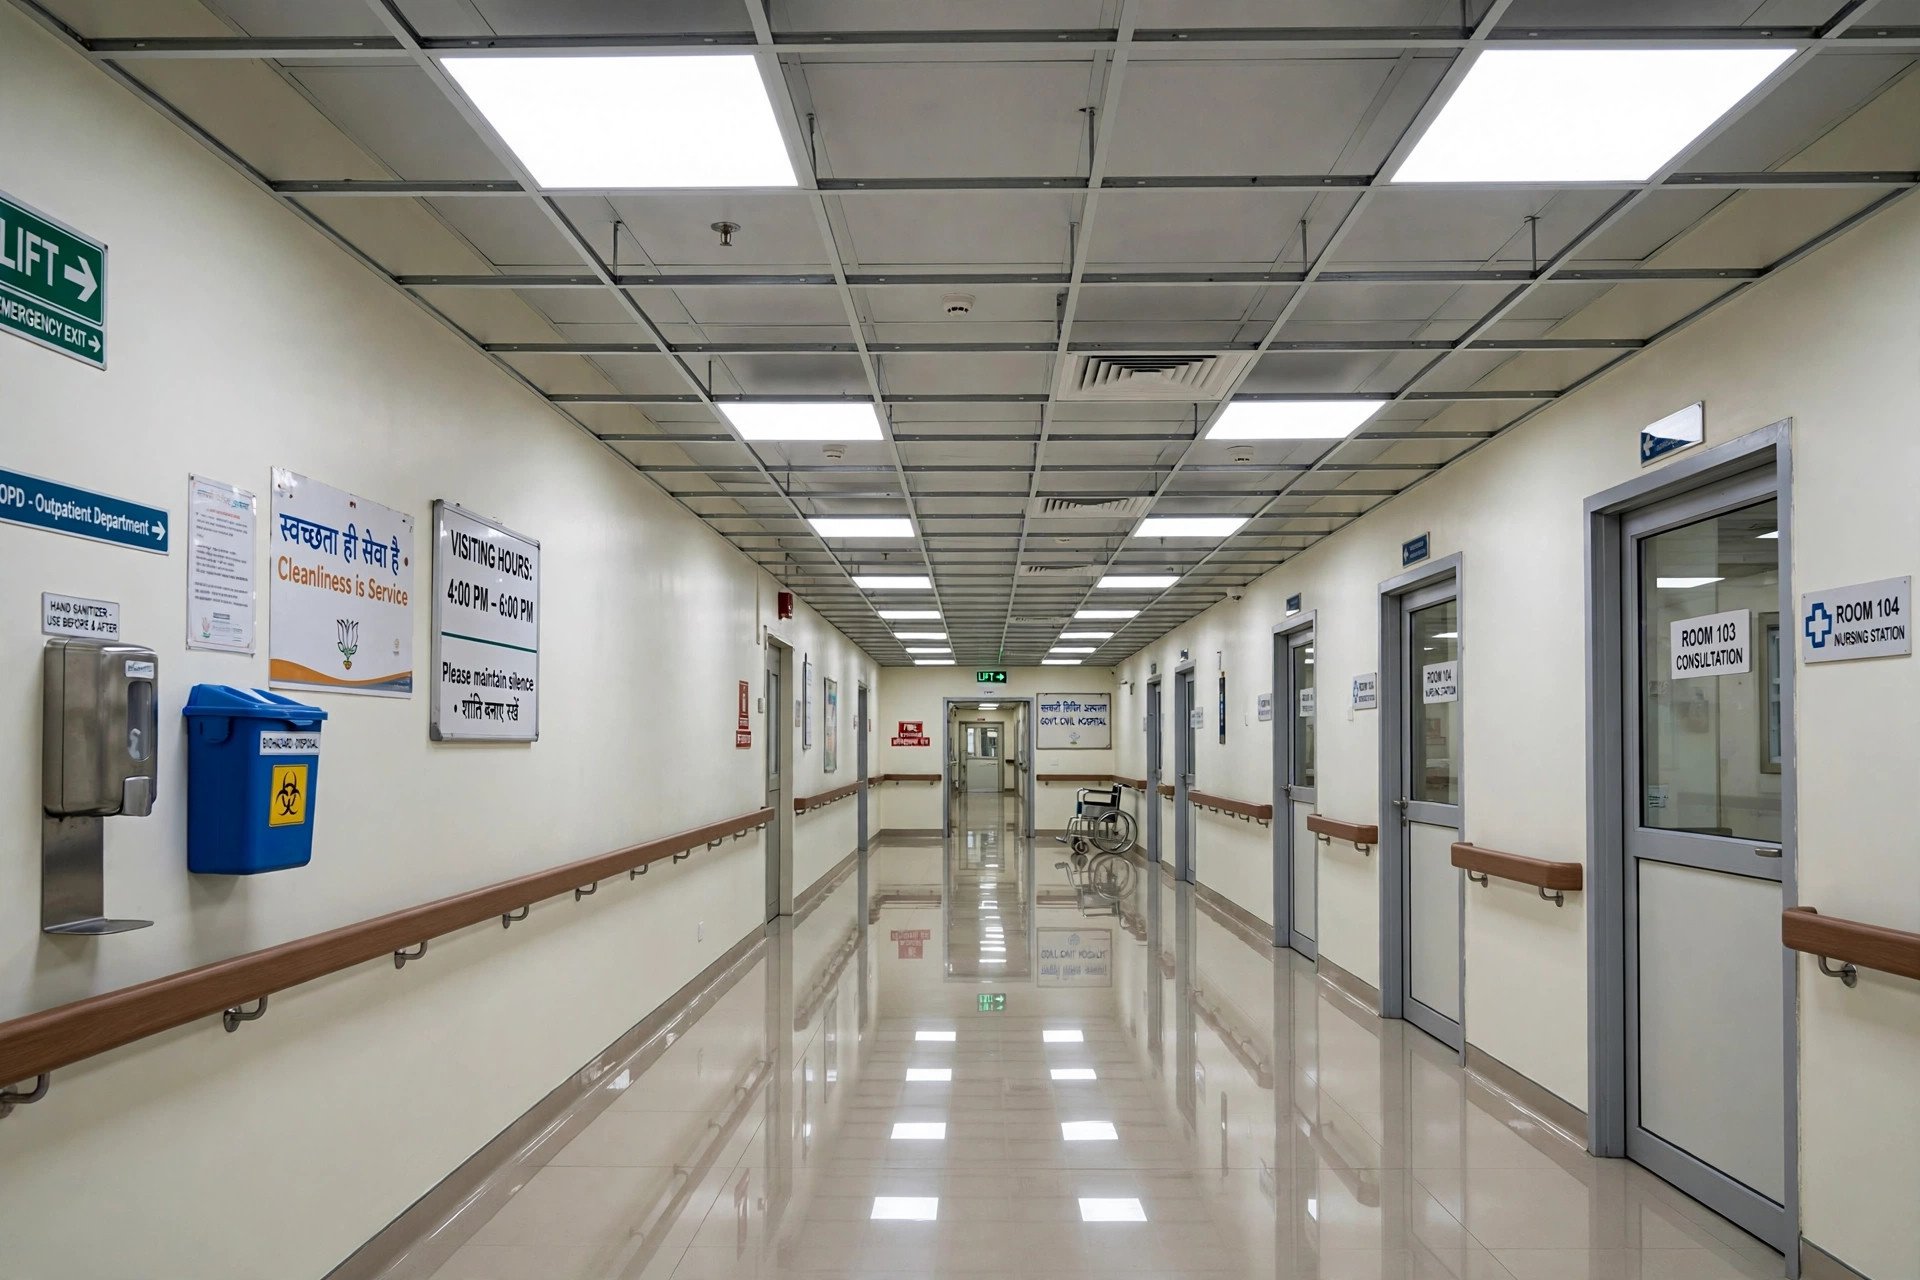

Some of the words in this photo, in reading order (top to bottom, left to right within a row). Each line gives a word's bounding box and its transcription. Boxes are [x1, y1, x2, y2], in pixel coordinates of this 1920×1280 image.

[0, 217, 60, 287] LIFT
[64, 324, 87, 348] EXIT
[0, 484, 25, 508] OPD
[35, 493, 92, 523] Outpatient
[93, 507, 150, 536] Department
[279, 512, 339, 555] स्वच्छता
[342, 523, 358, 563] ही
[362, 528, 388, 568] सेवा
[390, 535, 400, 575] है
[450, 529, 496, 569] VISITING
[497, 547, 532, 581] HOURS:
[277, 555, 352, 595] Cleanliness
[355, 573, 365, 597] is
[368, 578, 408, 606] Service
[50, 601, 71, 614] HAND
[447, 578, 471, 607] 4:00
[473, 584, 489, 612] PM
[499, 593, 519, 619] 6:00
[520, 598, 534, 623] PM
[1836, 600, 1873, 624] ROOM
[1876, 596, 1900, 618] 104
[47, 615, 61, 627] USE
[96, 621, 118, 633] AFTER
[1682, 626, 1713, 648] ROOM
[1716, 622, 1736, 643] 103
[1833, 629, 1869, 647] NURSING
[1870, 625, 1905, 643] STATION
[1676, 647, 1743, 670] CONSULTATION
[442, 661, 471, 685] Please
[473, 667, 507, 689] maintain
